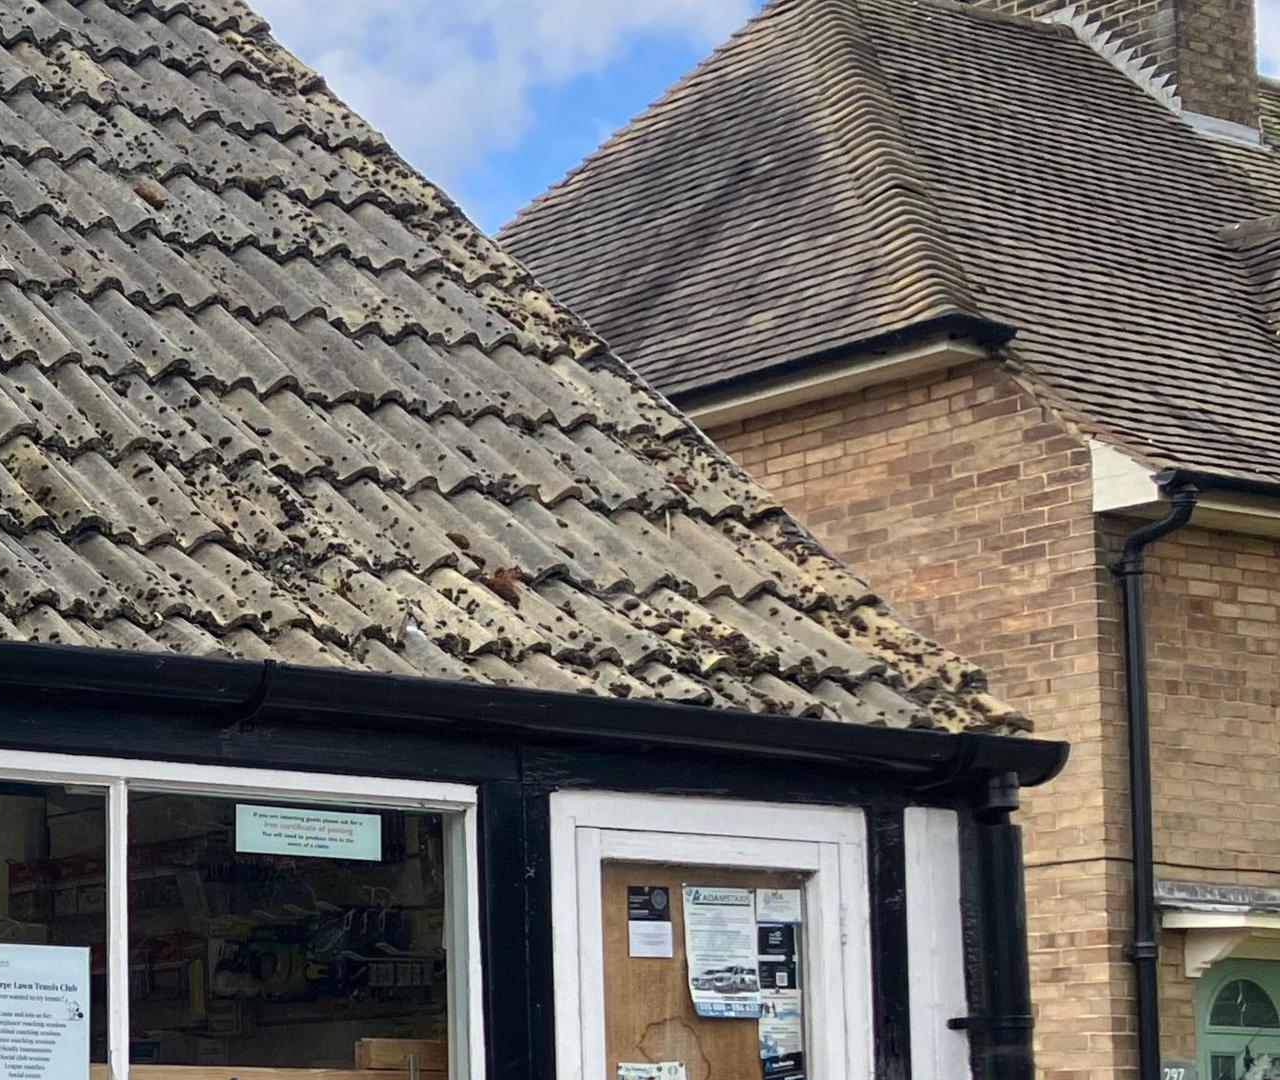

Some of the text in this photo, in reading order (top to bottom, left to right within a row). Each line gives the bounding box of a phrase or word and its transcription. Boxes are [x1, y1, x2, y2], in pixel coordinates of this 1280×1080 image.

[14, 982, 33, 990] Lawn
[35, 983, 59, 991] Tennis
[60, 984, 78, 992] Club
